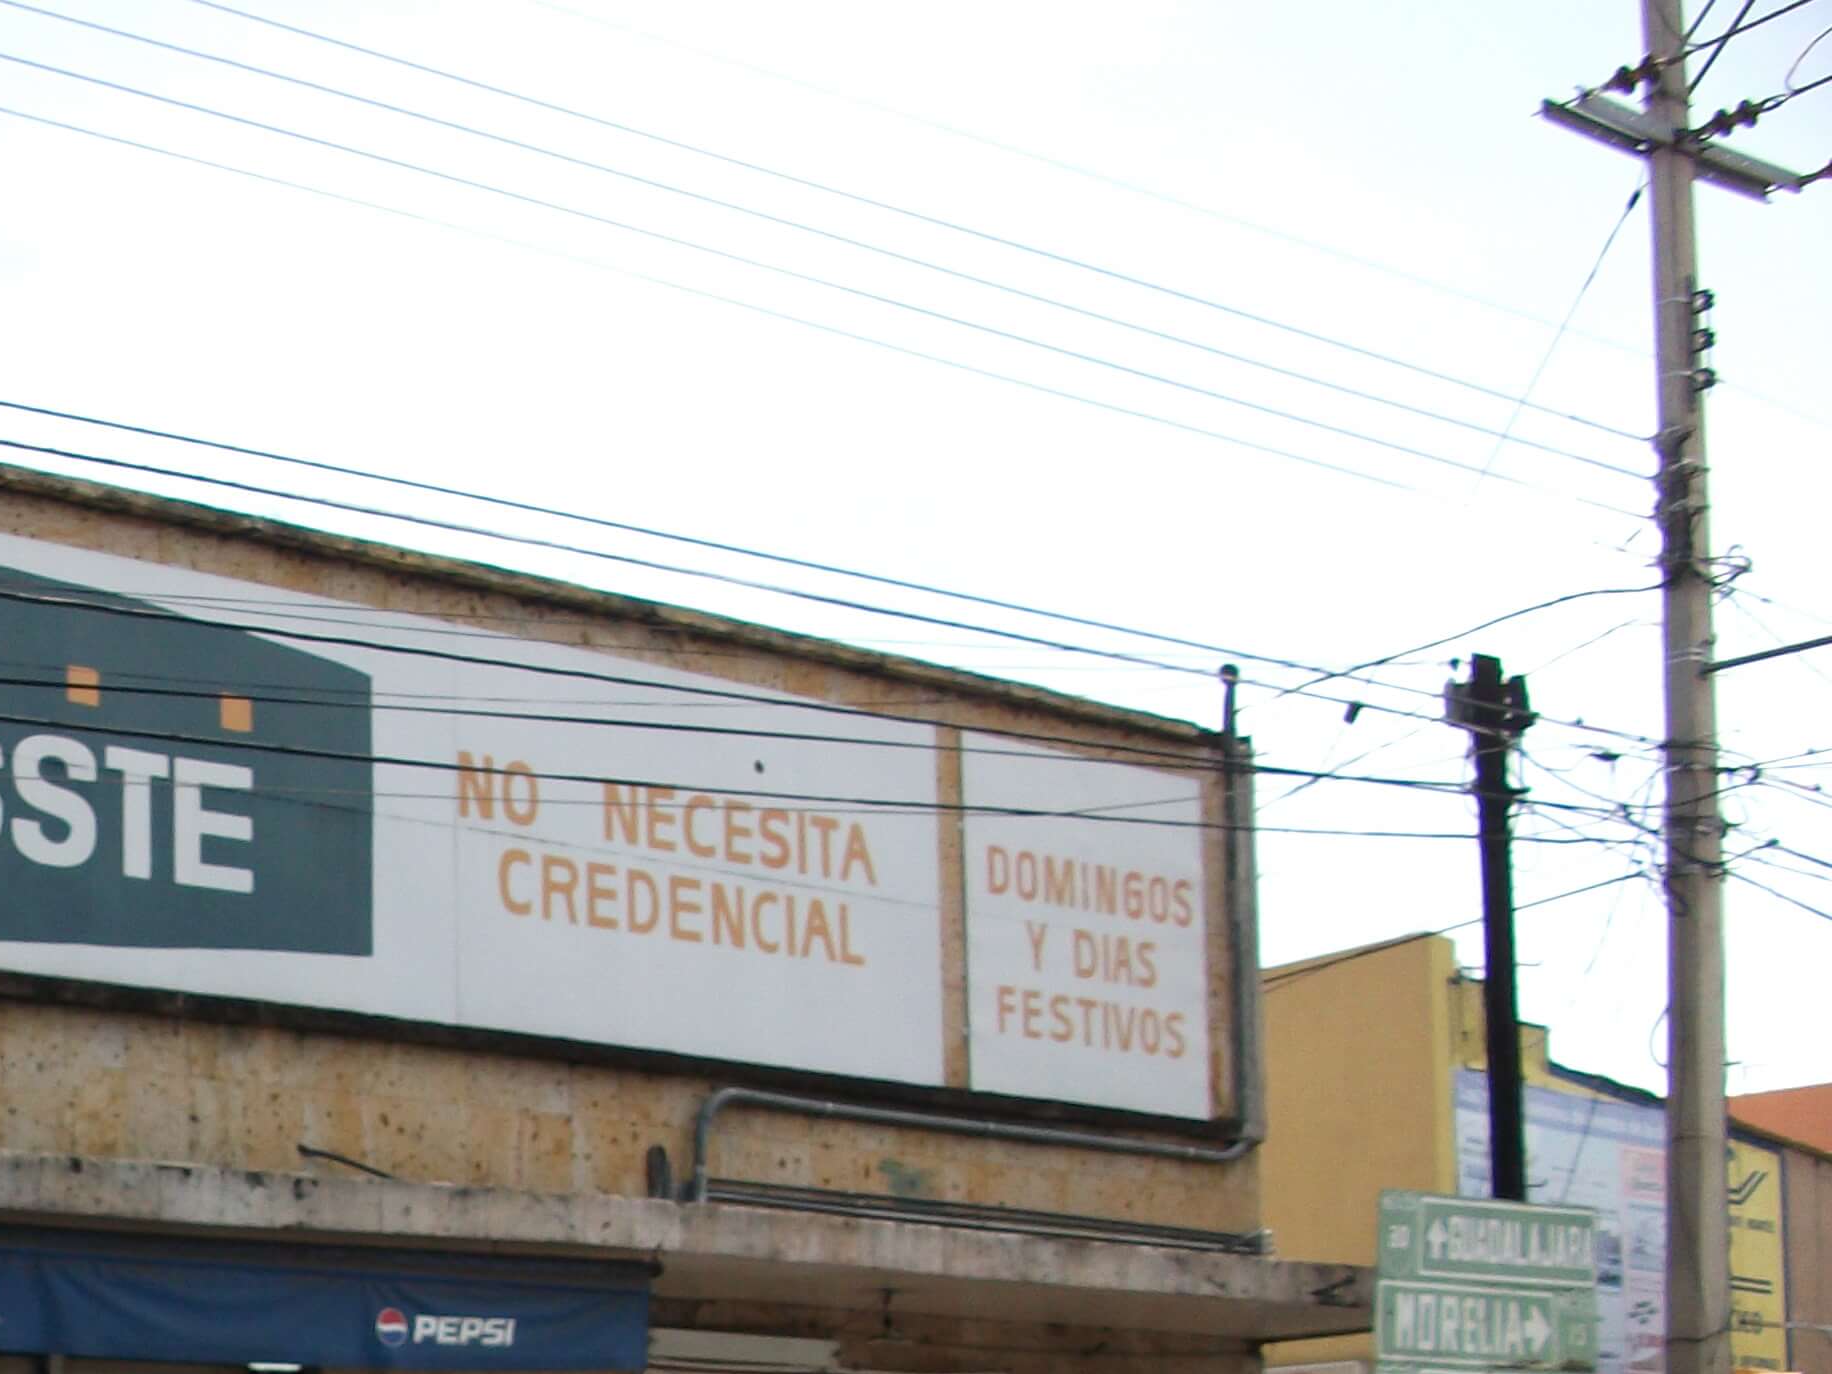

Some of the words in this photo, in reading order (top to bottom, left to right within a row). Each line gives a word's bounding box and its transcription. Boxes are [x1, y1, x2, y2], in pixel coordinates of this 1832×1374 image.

[457, 751, 539, 827] NO
[602, 781, 879, 886] NECESITA
[497, 848, 866, 966] CREDENCIAL
[986, 844, 1193, 928] DOMINGOS
[1025, 919, 1049, 974] Y
[1072, 928, 1158, 988] DIAS
[996, 984, 1186, 1059] FESTIVOS
[1448, 1214, 1594, 1268] GUADALAJARA
[413, 1314, 516, 1347] PEPSI
[1395, 1292, 1524, 1356] MORELIA
